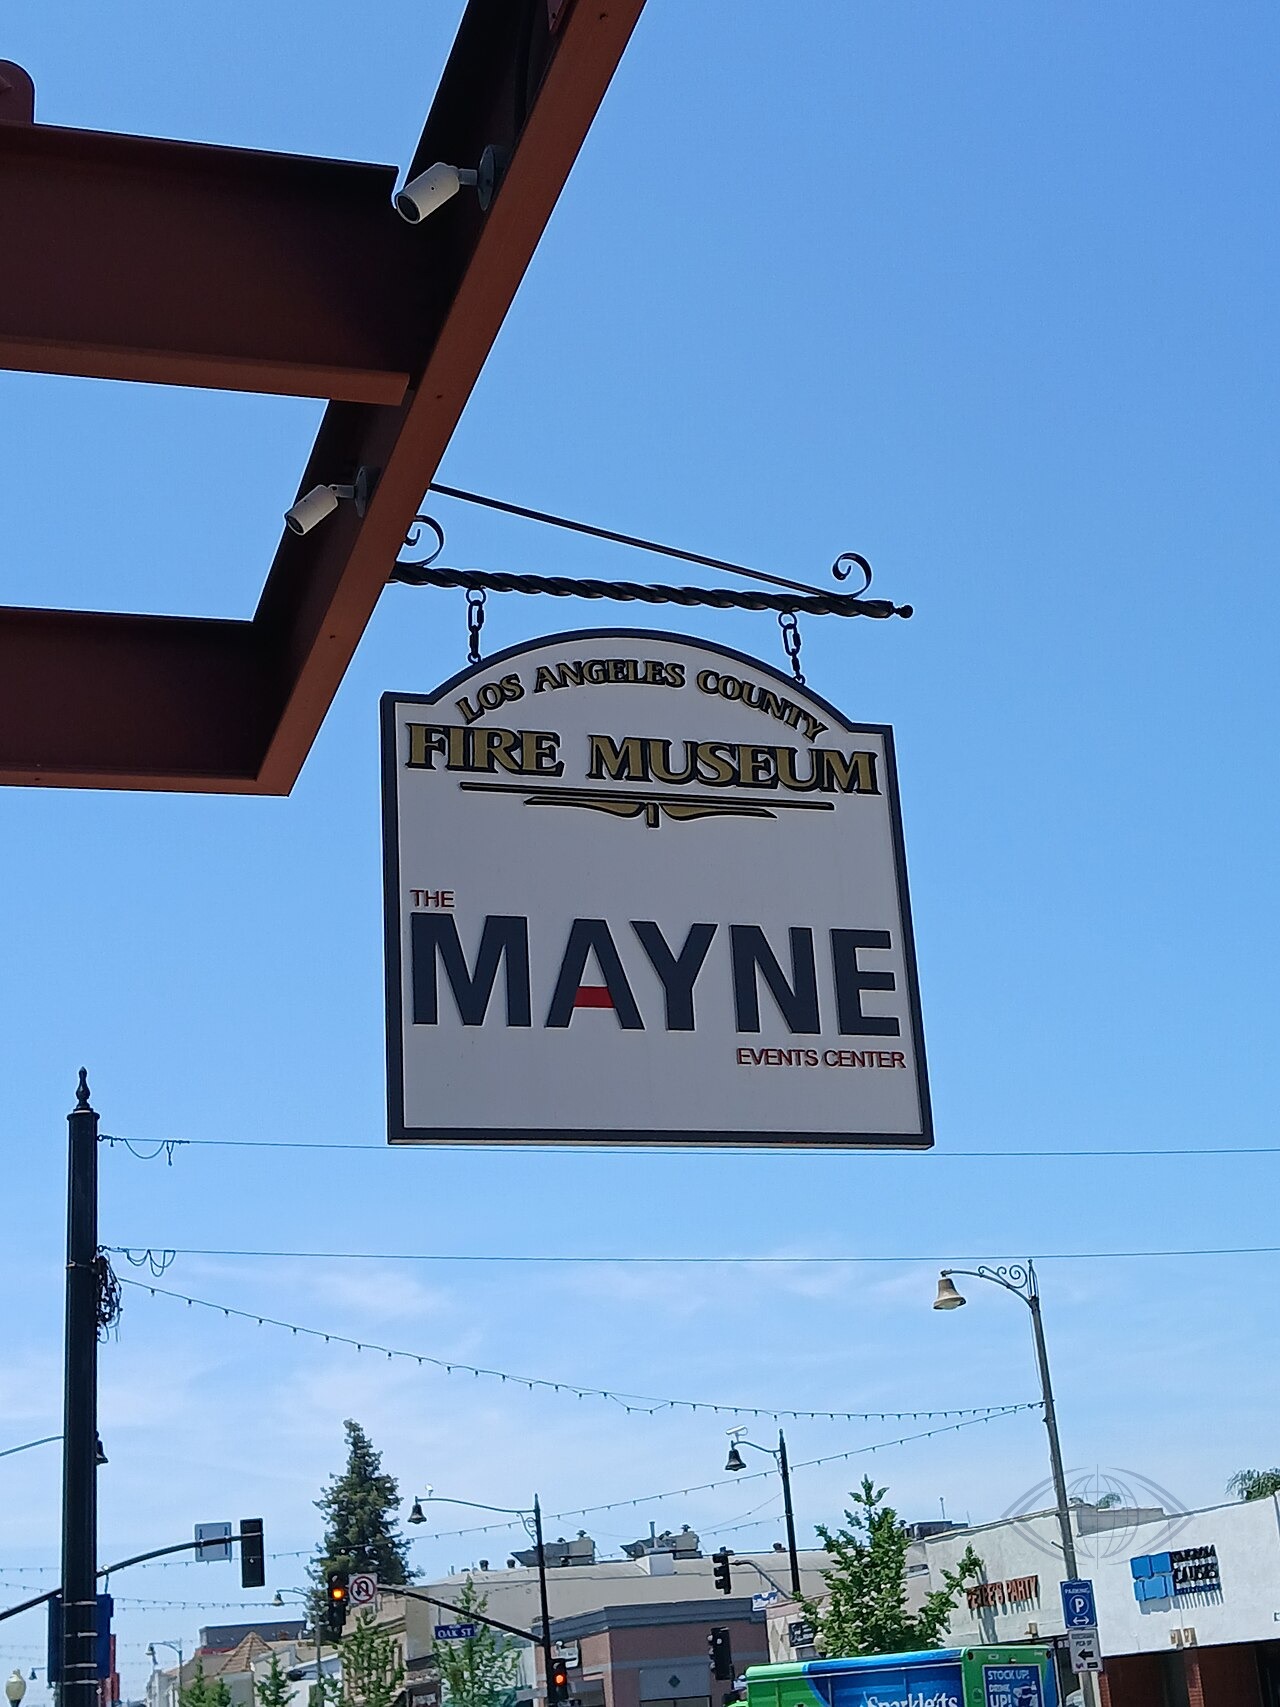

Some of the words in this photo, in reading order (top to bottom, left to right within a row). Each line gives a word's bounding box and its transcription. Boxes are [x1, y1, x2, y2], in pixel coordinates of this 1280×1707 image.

[456, 674, 524, 724] LOS
[534, 660, 685, 692] ANGELES
[697, 669, 829, 742] COUNTY
[405, 723, 564, 777] FIRE
[588, 735, 882, 795] MUSEUM
[410, 889, 455, 908] THE
[411, 912, 901, 1036] MAYNE
[737, 1048, 819, 1067] EVENTS
[824, 1049, 906, 1069] CENTER
[1006, 1575, 1038, 1602] PARTY
[438, 1629, 458, 1638] OAK
[461, 1628, 472, 1637] ST
[988, 1669, 1015, 1680] STOCK
